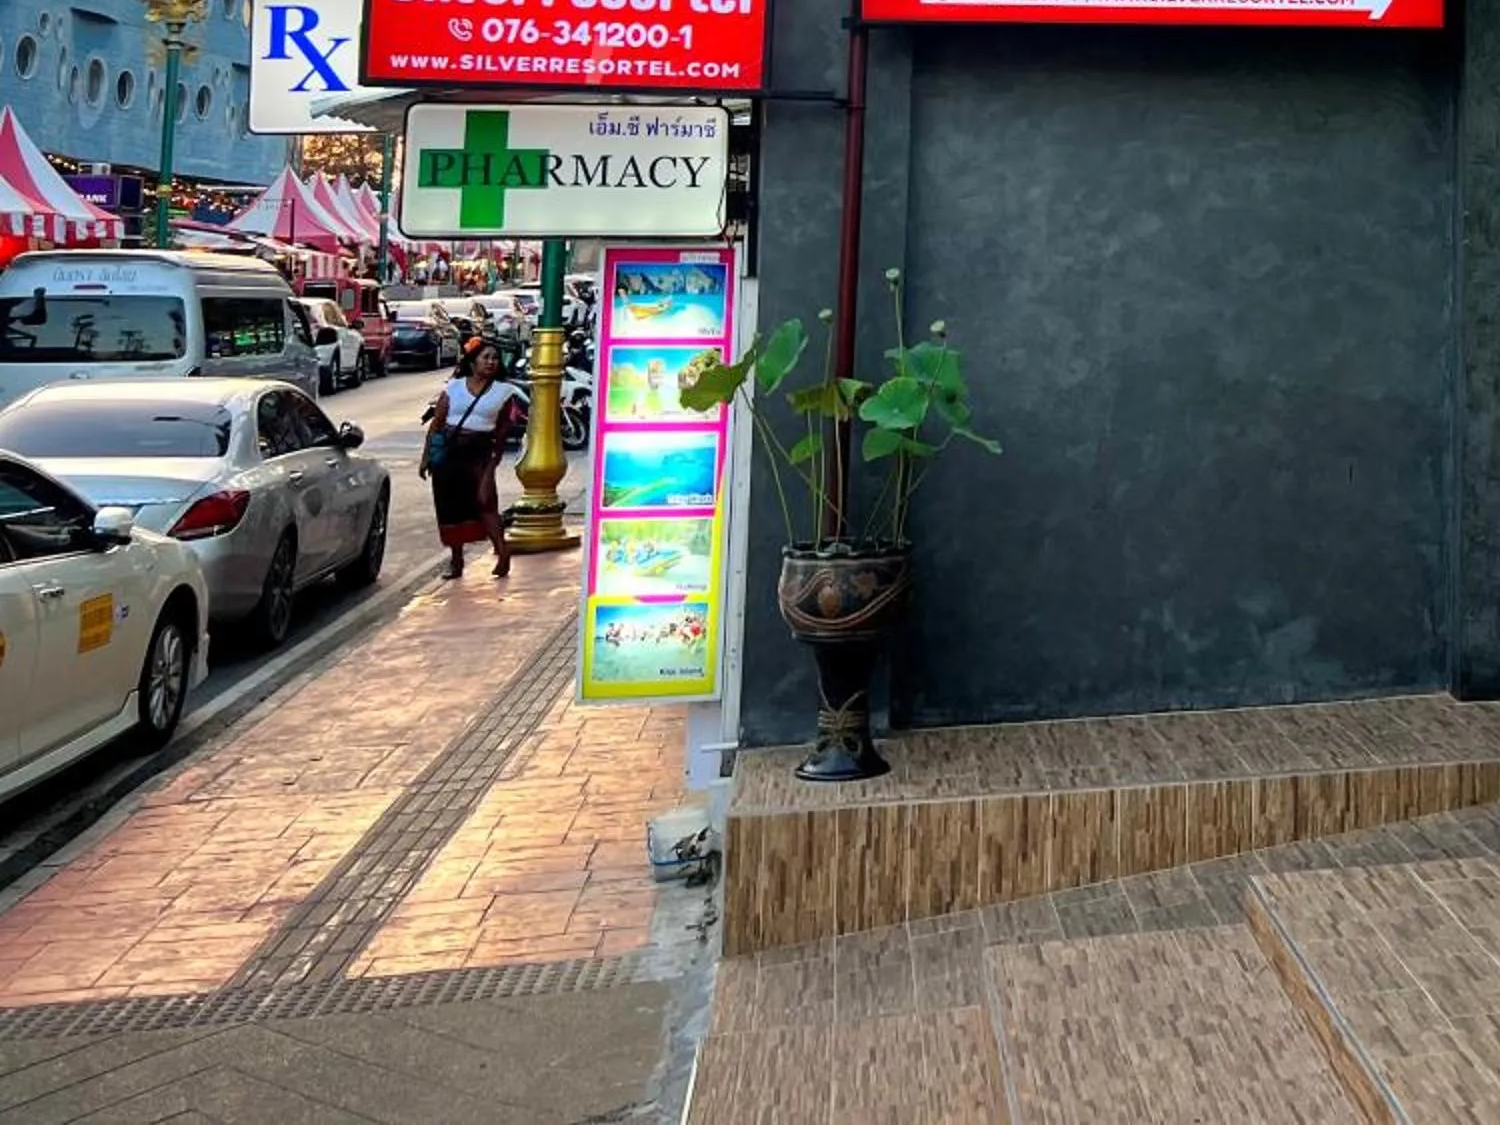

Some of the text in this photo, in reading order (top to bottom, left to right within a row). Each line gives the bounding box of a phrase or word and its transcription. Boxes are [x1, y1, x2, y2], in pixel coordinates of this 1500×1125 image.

[481, 18, 693, 50] 076-341200-1
[646, 115, 717, 138] ฟาร์มาซี
[428, 150, 711, 189] PHARMACY
[81, 193, 107, 203] ANK
